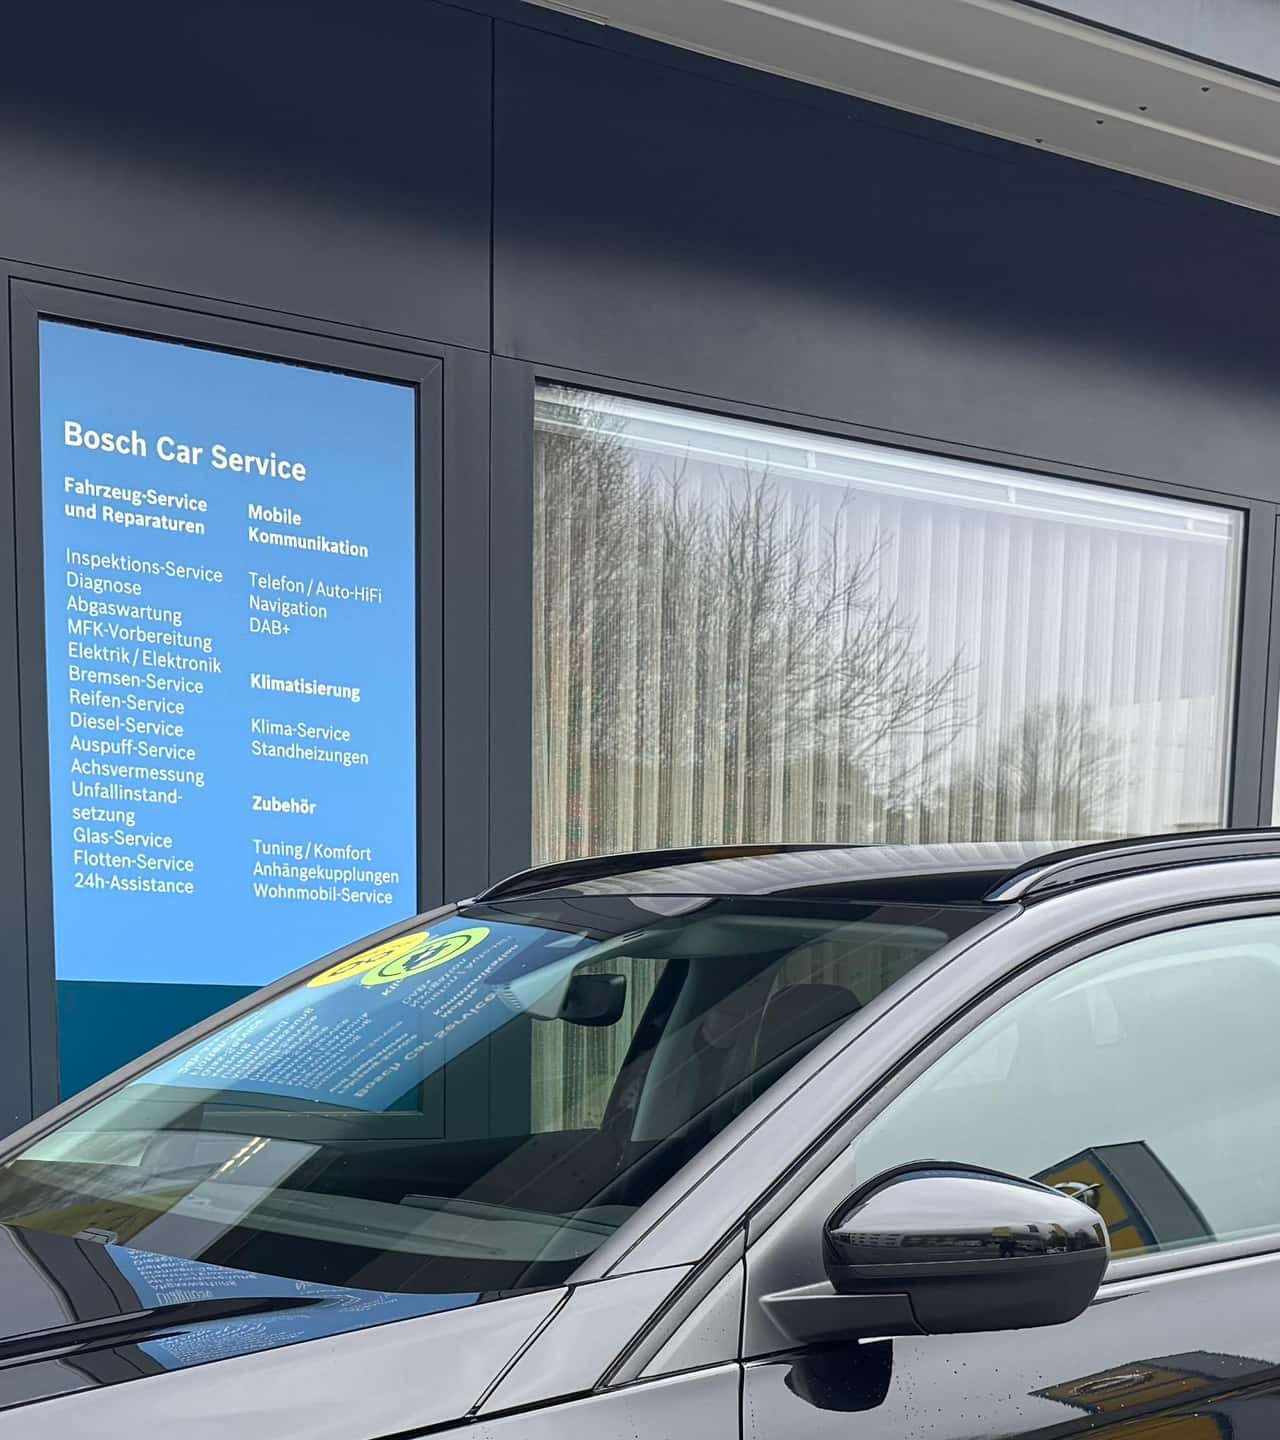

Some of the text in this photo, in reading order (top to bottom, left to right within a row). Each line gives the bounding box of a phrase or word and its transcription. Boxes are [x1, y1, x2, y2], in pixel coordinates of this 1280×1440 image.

[65, 421, 306, 481] Bosch Car Service
[65, 477, 208, 512] Fahrzeug-Service
[65, 502, 205, 535] und Reparaturen
[249, 504, 301, 525] Mobile
[249, 527, 368, 557] Kommunikation
[67, 548, 222, 583] Inspektions-Service
[67, 572, 142, 595] Diagnose
[249, 572, 304, 593] Telefon
[316, 581, 382, 603] Auto-HiFi
[67, 595, 182, 626] Abgaswartung
[250, 595, 327, 619] Navigation
[68, 619, 212, 652] MFK-Vorbereitung
[250, 617, 290, 635] DAB+
[69, 644, 130, 664] Elektrik
[142, 651, 221, 673] Elektronik
[69, 666, 204, 694] Bremsen-Service
[251, 674, 360, 702] Klimatisierung
[70, 689, 185, 715] Reifen-Service
[70, 712, 184, 737] Diesel-Service
[251, 718, 350, 741] Klima-Service
[71, 736, 195, 761] Auspuff-Service
[252, 740, 368, 766] Standheizungen
[71, 759, 204, 787] Achsvermessung
[72, 781, 182, 804] Unfallinstand-
[73, 807, 135, 826] setzung
[252, 796, 316, 815] Zubehör
[73, 827, 172, 848] Glas-Service
[254, 839, 303, 860] Tuning
[314, 842, 371, 861] Komfort
[74, 850, 194, 872] Flotten-Service
[254, 861, 399, 885] Anhängekupplungen
[74, 873, 194, 894] 24h-Assistance
[254, 883, 393, 904] Wohnmobil-Service
